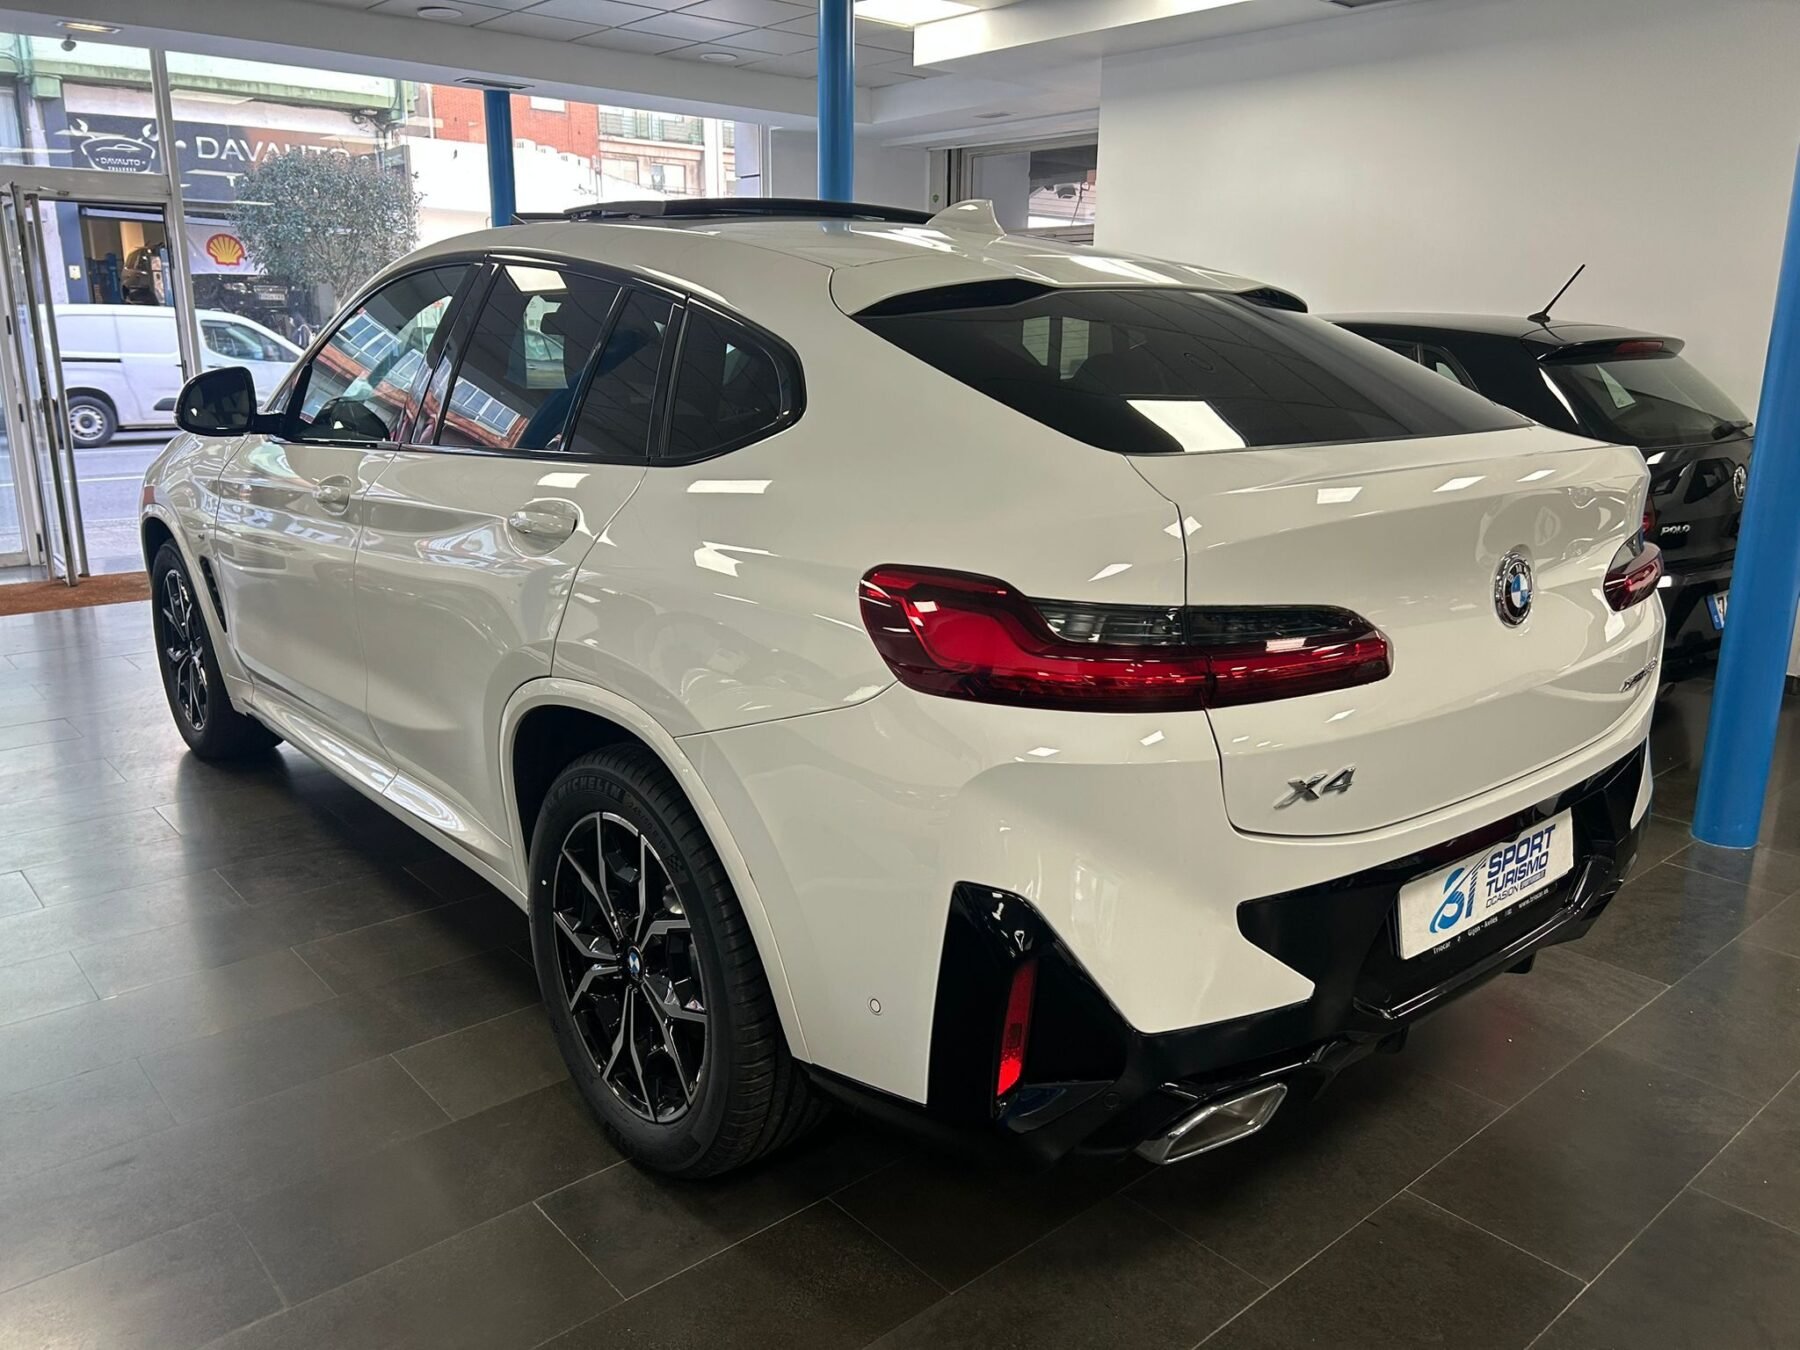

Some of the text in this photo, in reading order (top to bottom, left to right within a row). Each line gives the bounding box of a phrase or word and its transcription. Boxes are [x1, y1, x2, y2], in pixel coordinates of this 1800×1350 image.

[100, 157, 141, 166] DAVAUTO
[1660, 524, 1691, 536] POLO
[557, 776, 623, 800] MICHELIN
[1273, 766, 1356, 810] X4
[1487, 823, 1556, 879] SPORT
[1486, 851, 1549, 897] TURISMO
[1485, 884, 1519, 908] OCASION
